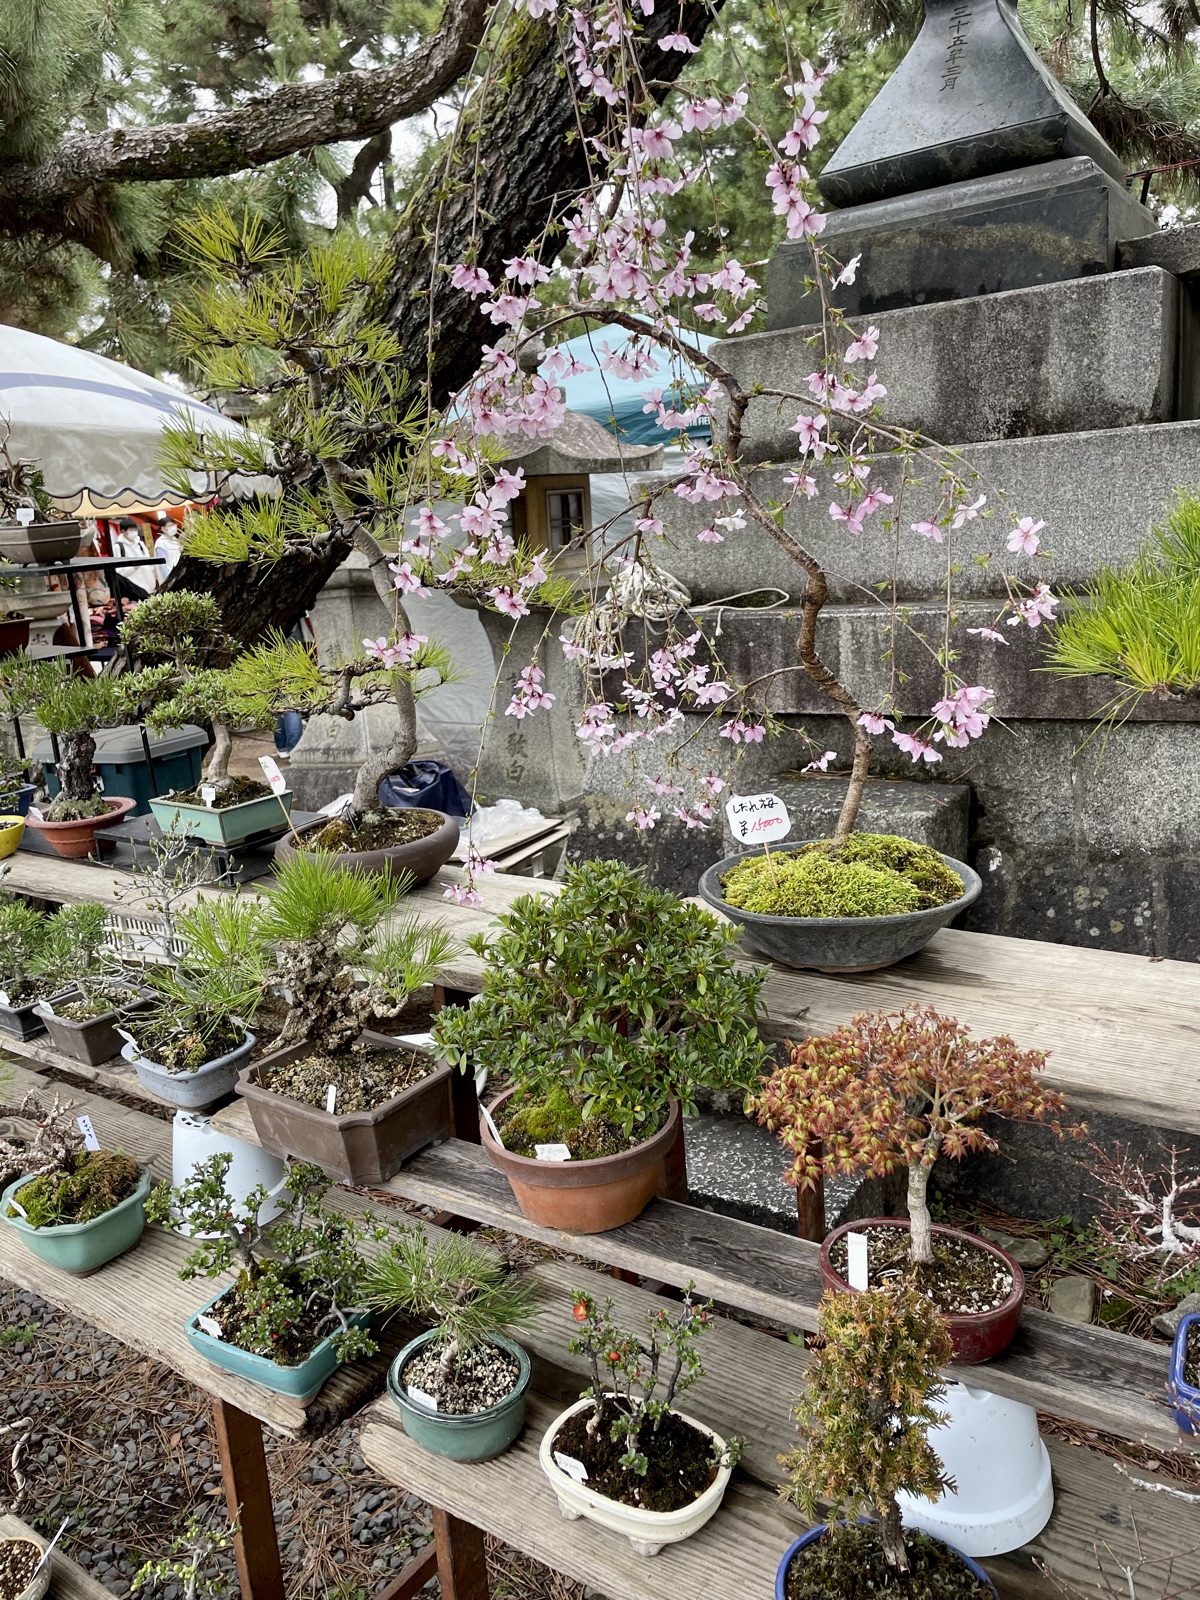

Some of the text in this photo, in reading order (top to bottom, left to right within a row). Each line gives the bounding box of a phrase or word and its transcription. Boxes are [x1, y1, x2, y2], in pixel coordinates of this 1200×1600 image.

[939, 0, 972, 92] 三十五年三月
